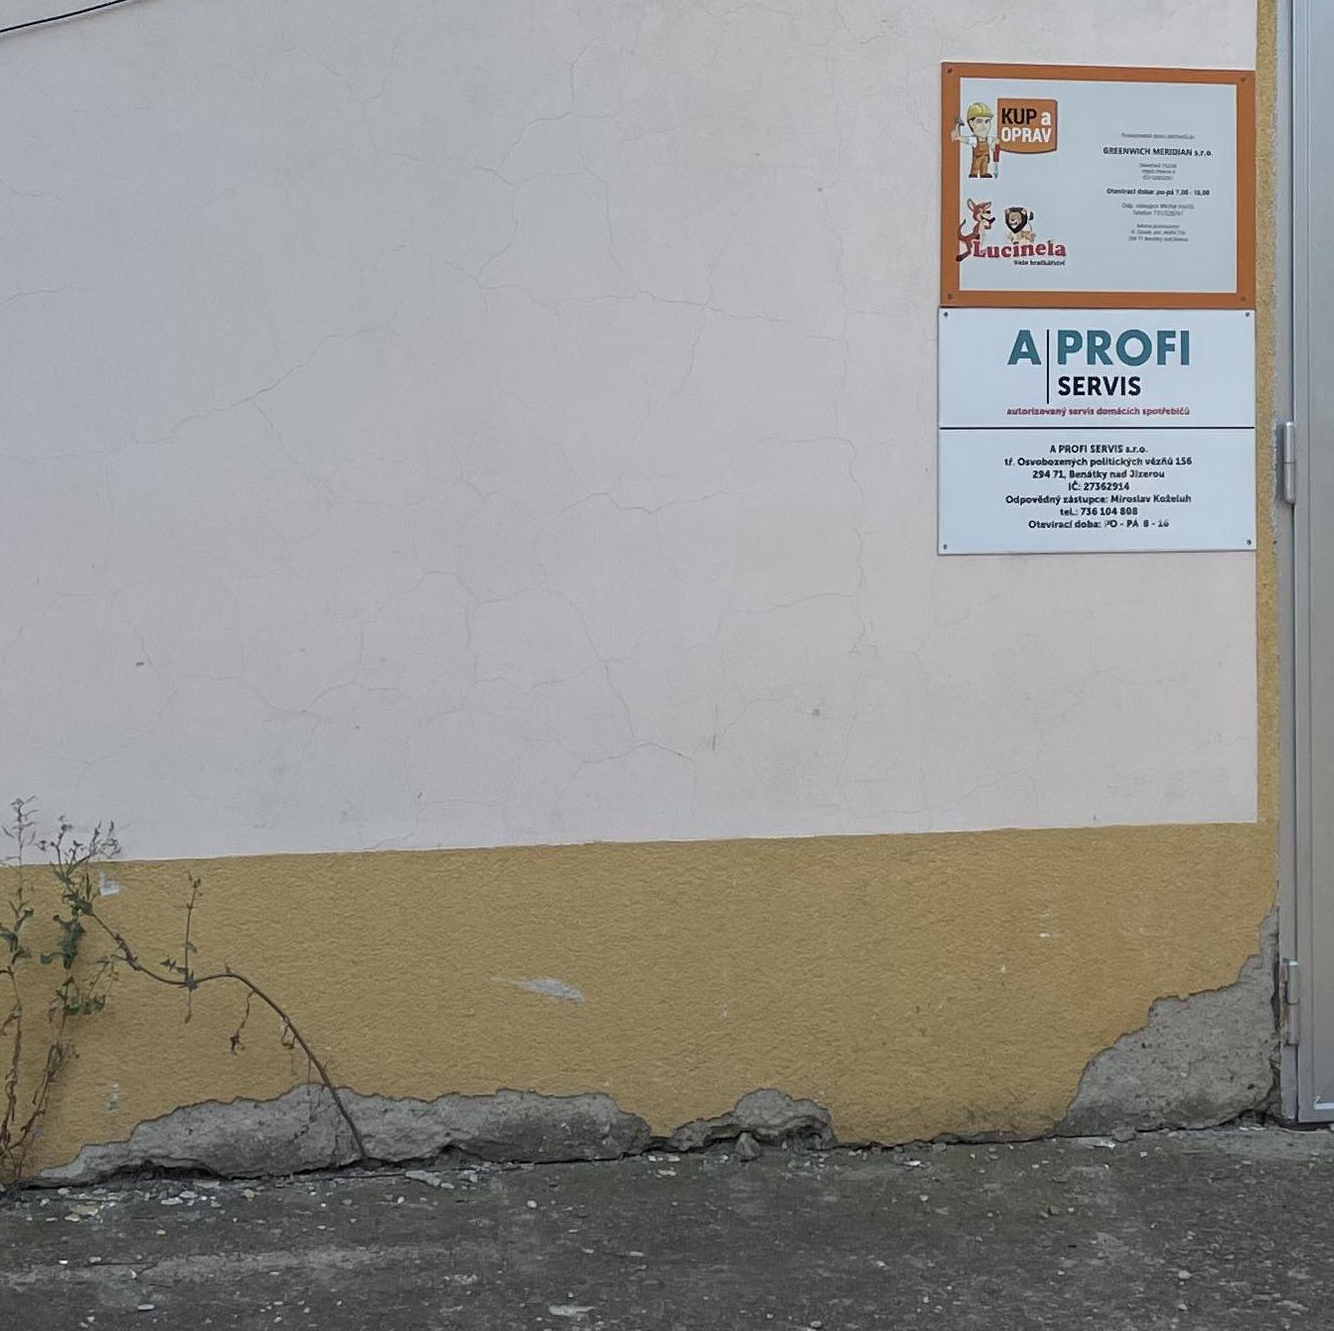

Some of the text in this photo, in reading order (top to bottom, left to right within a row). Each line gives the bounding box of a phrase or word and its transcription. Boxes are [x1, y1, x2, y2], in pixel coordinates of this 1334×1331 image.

[1001, 108, 1051, 125] KUP a
[1001, 127, 1052, 142] OPRAV
[1103, 147, 1151, 155] GREENWICH
[1153, 148, 1193, 156] MERIDIAN
[973, 240, 1066, 258] Lucinela
[1007, 329, 1190, 367] A PROFI
[1058, 376, 1141, 396] SERVIS
[1007, 406, 1190, 417] autorizovaný servis domácích spotřebičů
[1049, 445, 1056, 453] A
[1058, 445, 1087, 453] PROFI
[1090, 445, 1123, 453] SERVIS
[1017, 457, 1088, 468] Osvobozených
[1090, 457, 1143, 468] politických
[1175, 457, 1193, 466] 156
[1033, 470, 1051, 479] 294
[1069, 469, 1107, 480] Benátky
[1109, 469, 1127, 478] nad
[1129, 469, 1165, 478] Jizerou
[1083, 482, 1130, 491] 27362914
[1005, 493, 1191, 506] Odpovědný zástupce: Miroslav Koželuh
[1080, 507, 1098, 516] 736
[1100, 507, 1117, 516] 104
